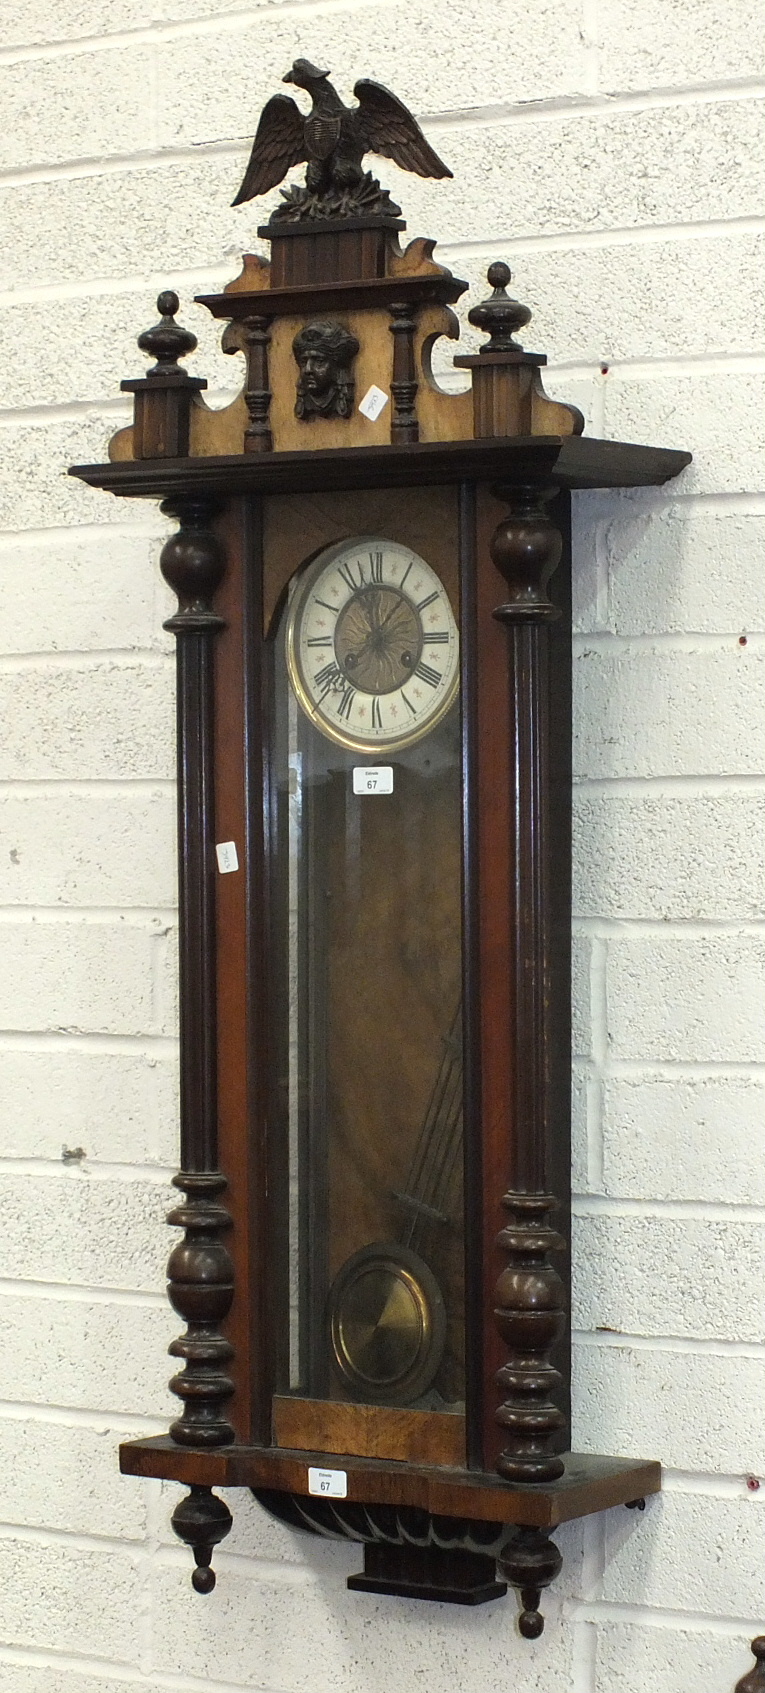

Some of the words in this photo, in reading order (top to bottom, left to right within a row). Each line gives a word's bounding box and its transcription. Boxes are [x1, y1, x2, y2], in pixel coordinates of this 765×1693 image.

[369, 552, 383, 583] XII
[400, 562, 413, 589] I
[415, 590, 441, 613] II
[422, 631, 450, 645] III
[414, 661, 442, 689] IIII
[370, 696, 383, 729] VI
[400, 689, 417, 714] V
[367, 780, 377, 789] 67
[321, 1482, 330, 1491] 67
